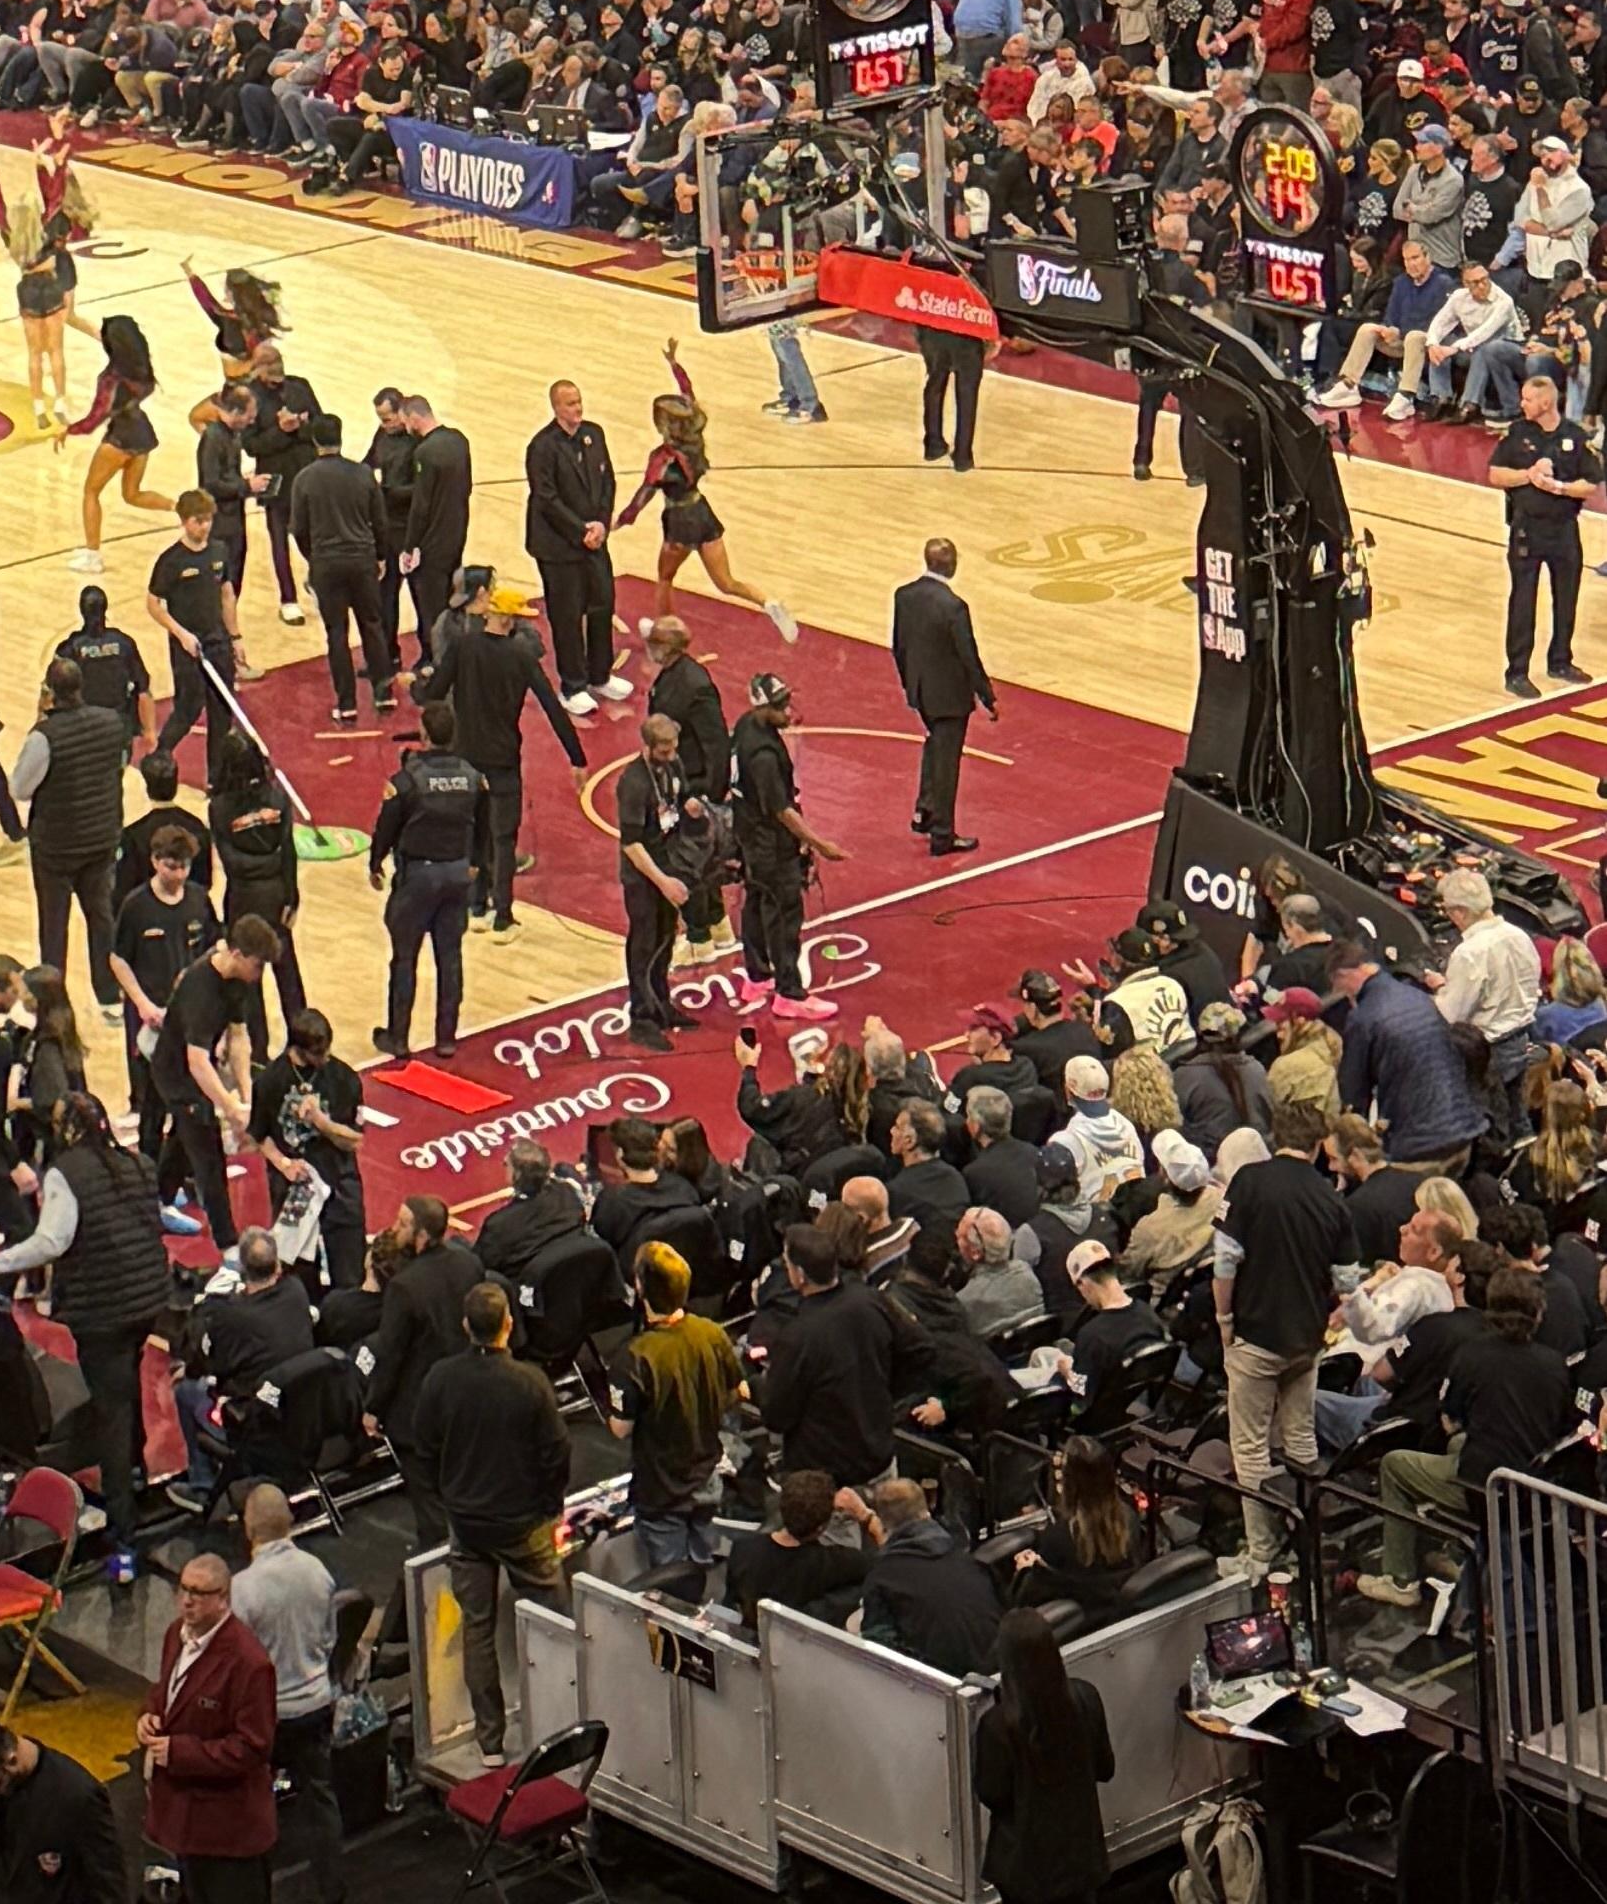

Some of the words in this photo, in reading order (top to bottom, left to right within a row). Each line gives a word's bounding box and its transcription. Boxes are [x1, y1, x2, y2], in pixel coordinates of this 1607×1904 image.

[856, 23, 930, 56] TISSOT
[438, 148, 525, 209] PLAYOFFS
[1265, 143, 1317, 183] 2:09
[1268, 180, 1309, 222] 14
[1267, 243, 1324, 269] TISSOT
[1034, 260, 1102, 304] Finals
[1204, 547, 1234, 582] GET
[1207, 582, 1237, 619] THE
[81, 642, 120, 658] POLICE
[1216, 622, 1247, 663] App
[429, 776, 469, 792] POLICE
[400, 1072, 671, 1174] Courtside
